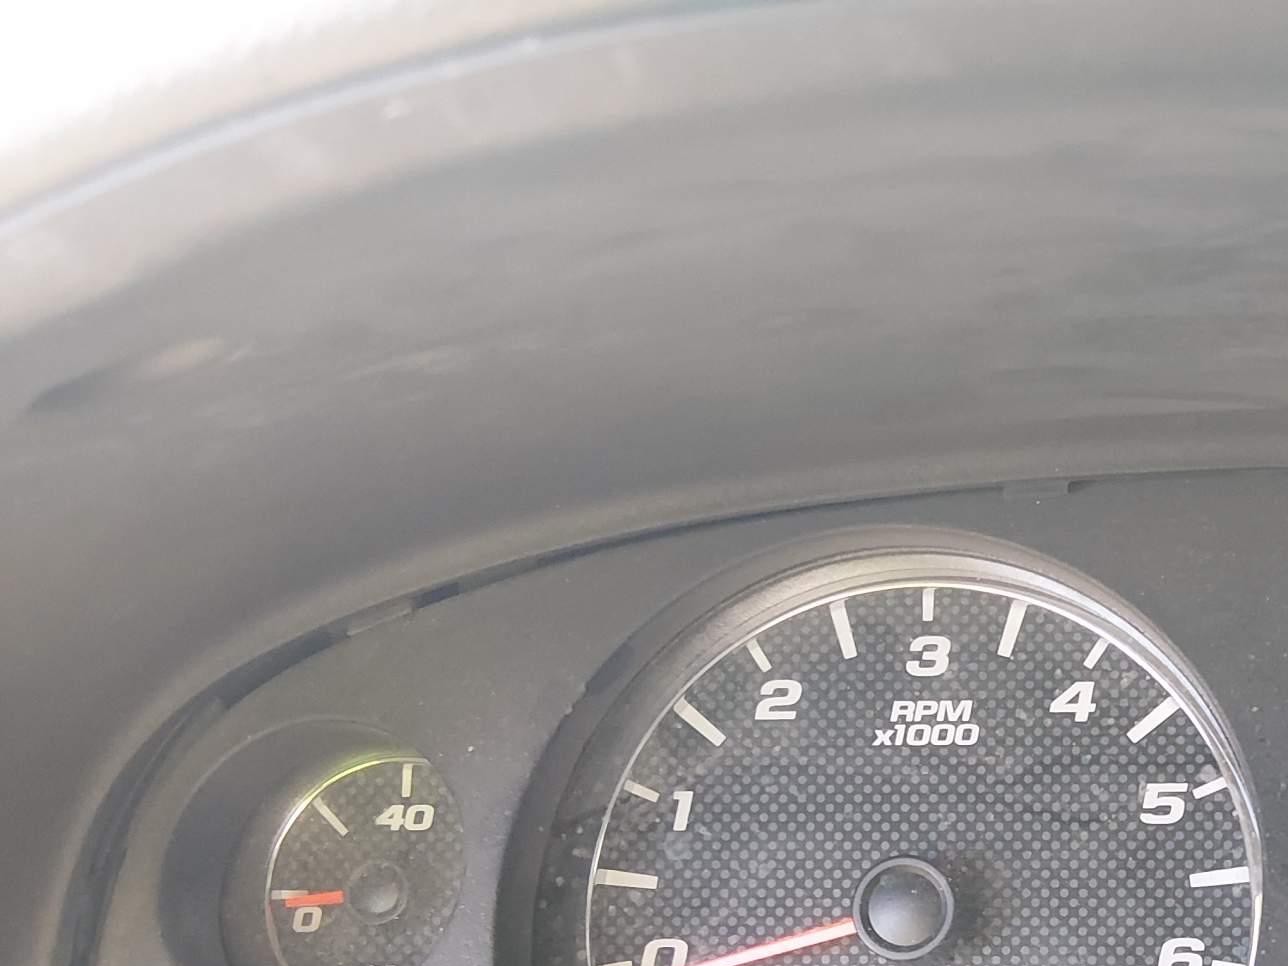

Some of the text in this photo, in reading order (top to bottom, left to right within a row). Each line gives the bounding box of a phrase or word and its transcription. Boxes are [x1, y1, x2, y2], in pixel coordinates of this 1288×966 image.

[906, 635, 951, 677] 3
[754, 679, 803, 720] 2
[890, 700, 974, 722] RPM
[1049, 681, 1097, 722] 4
[872, 724, 980, 746] x1000
[375, 804, 435, 831] 40
[672, 791, 694, 831] 1
[1139, 783, 1189, 825] 5
[292, 907, 323, 933] 0
